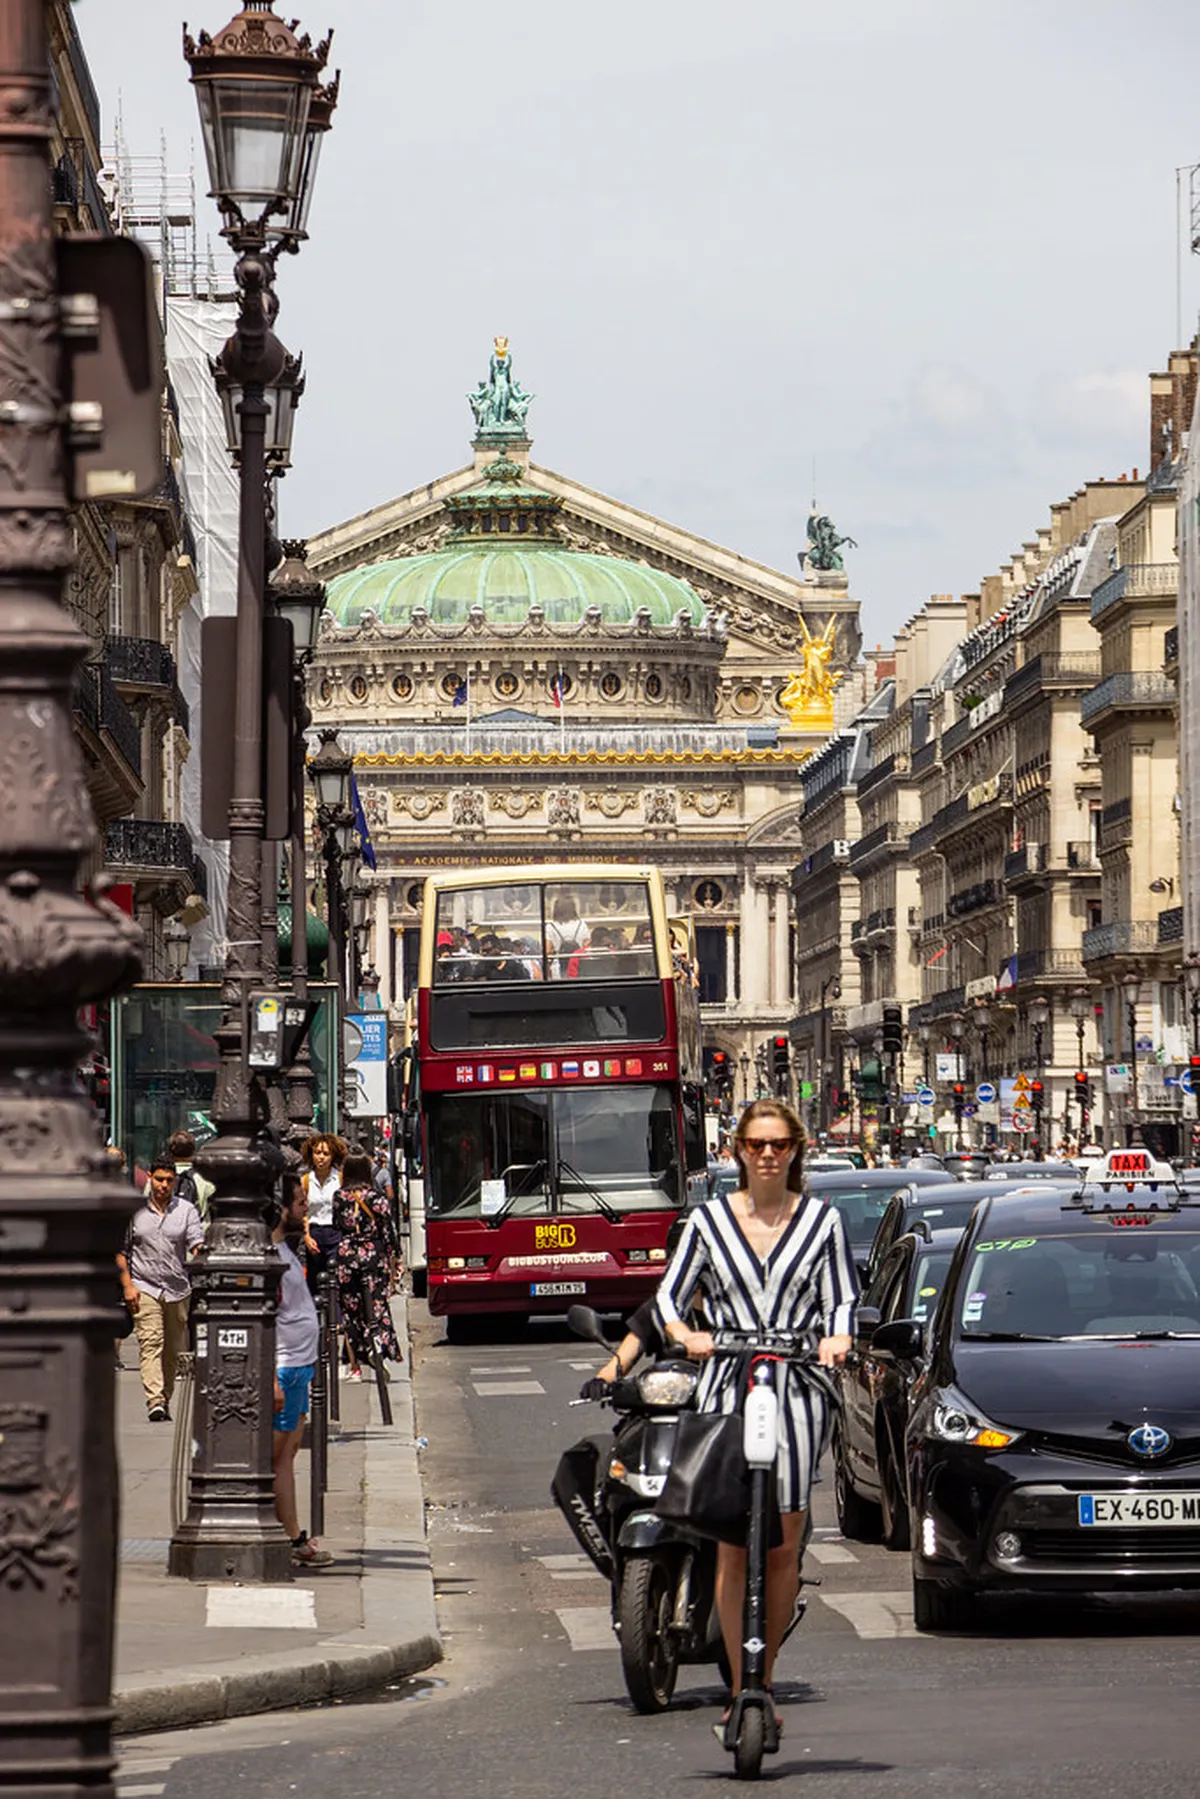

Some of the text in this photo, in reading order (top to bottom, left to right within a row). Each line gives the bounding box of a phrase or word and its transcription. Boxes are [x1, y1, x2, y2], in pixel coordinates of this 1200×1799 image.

[414, 856, 470, 865] ACADEMIE
[480, 856, 534, 865] NATIONALE
[652, 1062, 669, 1071] 351
[1112, 1155, 1147, 1170] TAXI
[535, 1225, 558, 1238] BIG
[535, 1238, 559, 1249] BUS
[221, 1333, 245, 1344] 4TH
[1094, 1499, 1200, 1521] EX-460-M
[570, 1493, 613, 1559] TWEET
